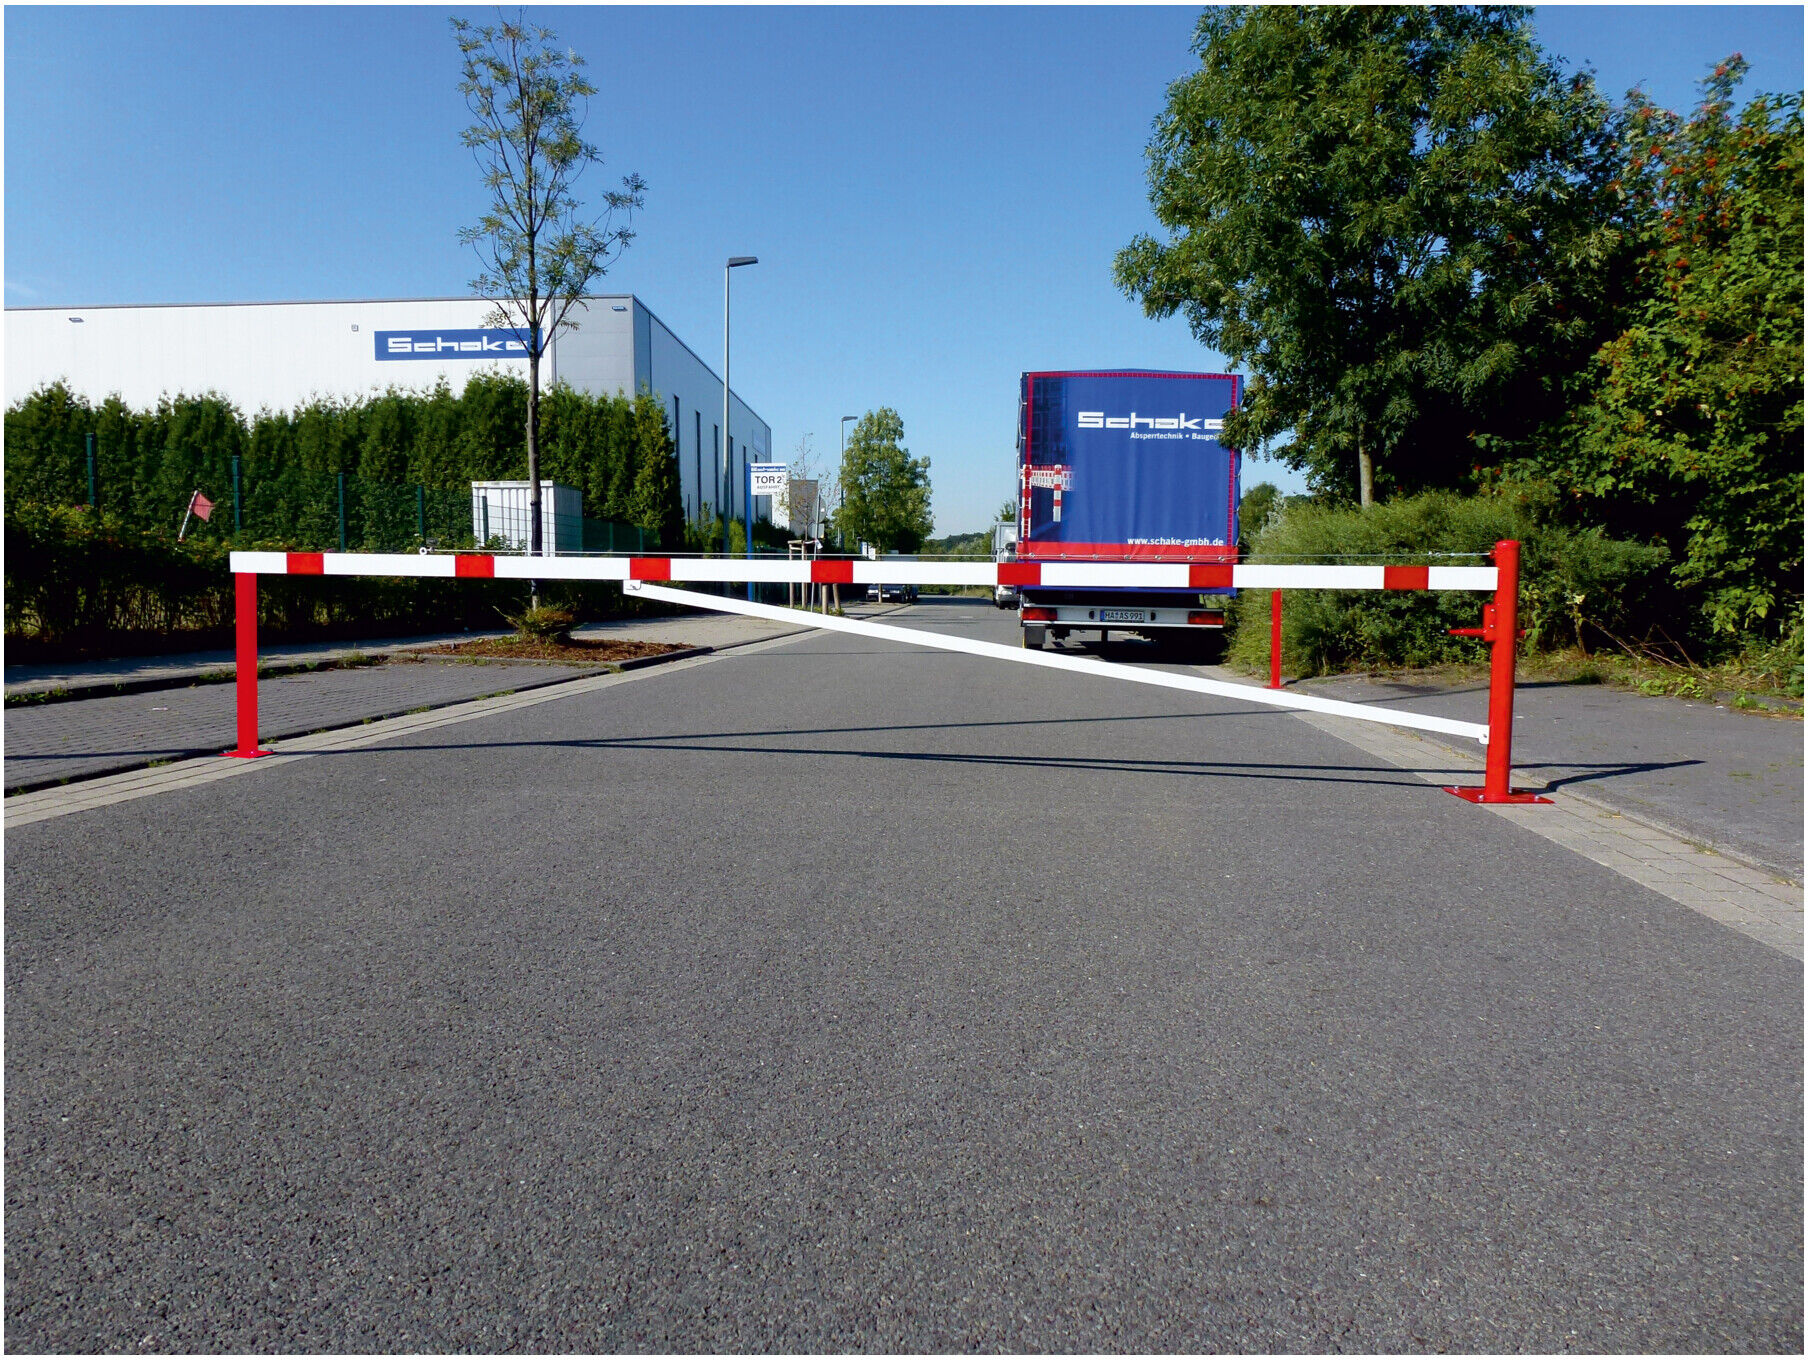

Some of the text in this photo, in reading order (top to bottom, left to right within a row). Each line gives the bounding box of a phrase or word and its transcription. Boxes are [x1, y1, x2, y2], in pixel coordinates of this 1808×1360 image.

[388, 336, 528, 353] Schake
[1078, 412, 1224, 430] Schake
[1130, 432, 1184, 440] Absperrtechnik
[755, 476, 782, 484] TOR 2
[1127, 537, 1224, 547] www.schake-gmbh.de
